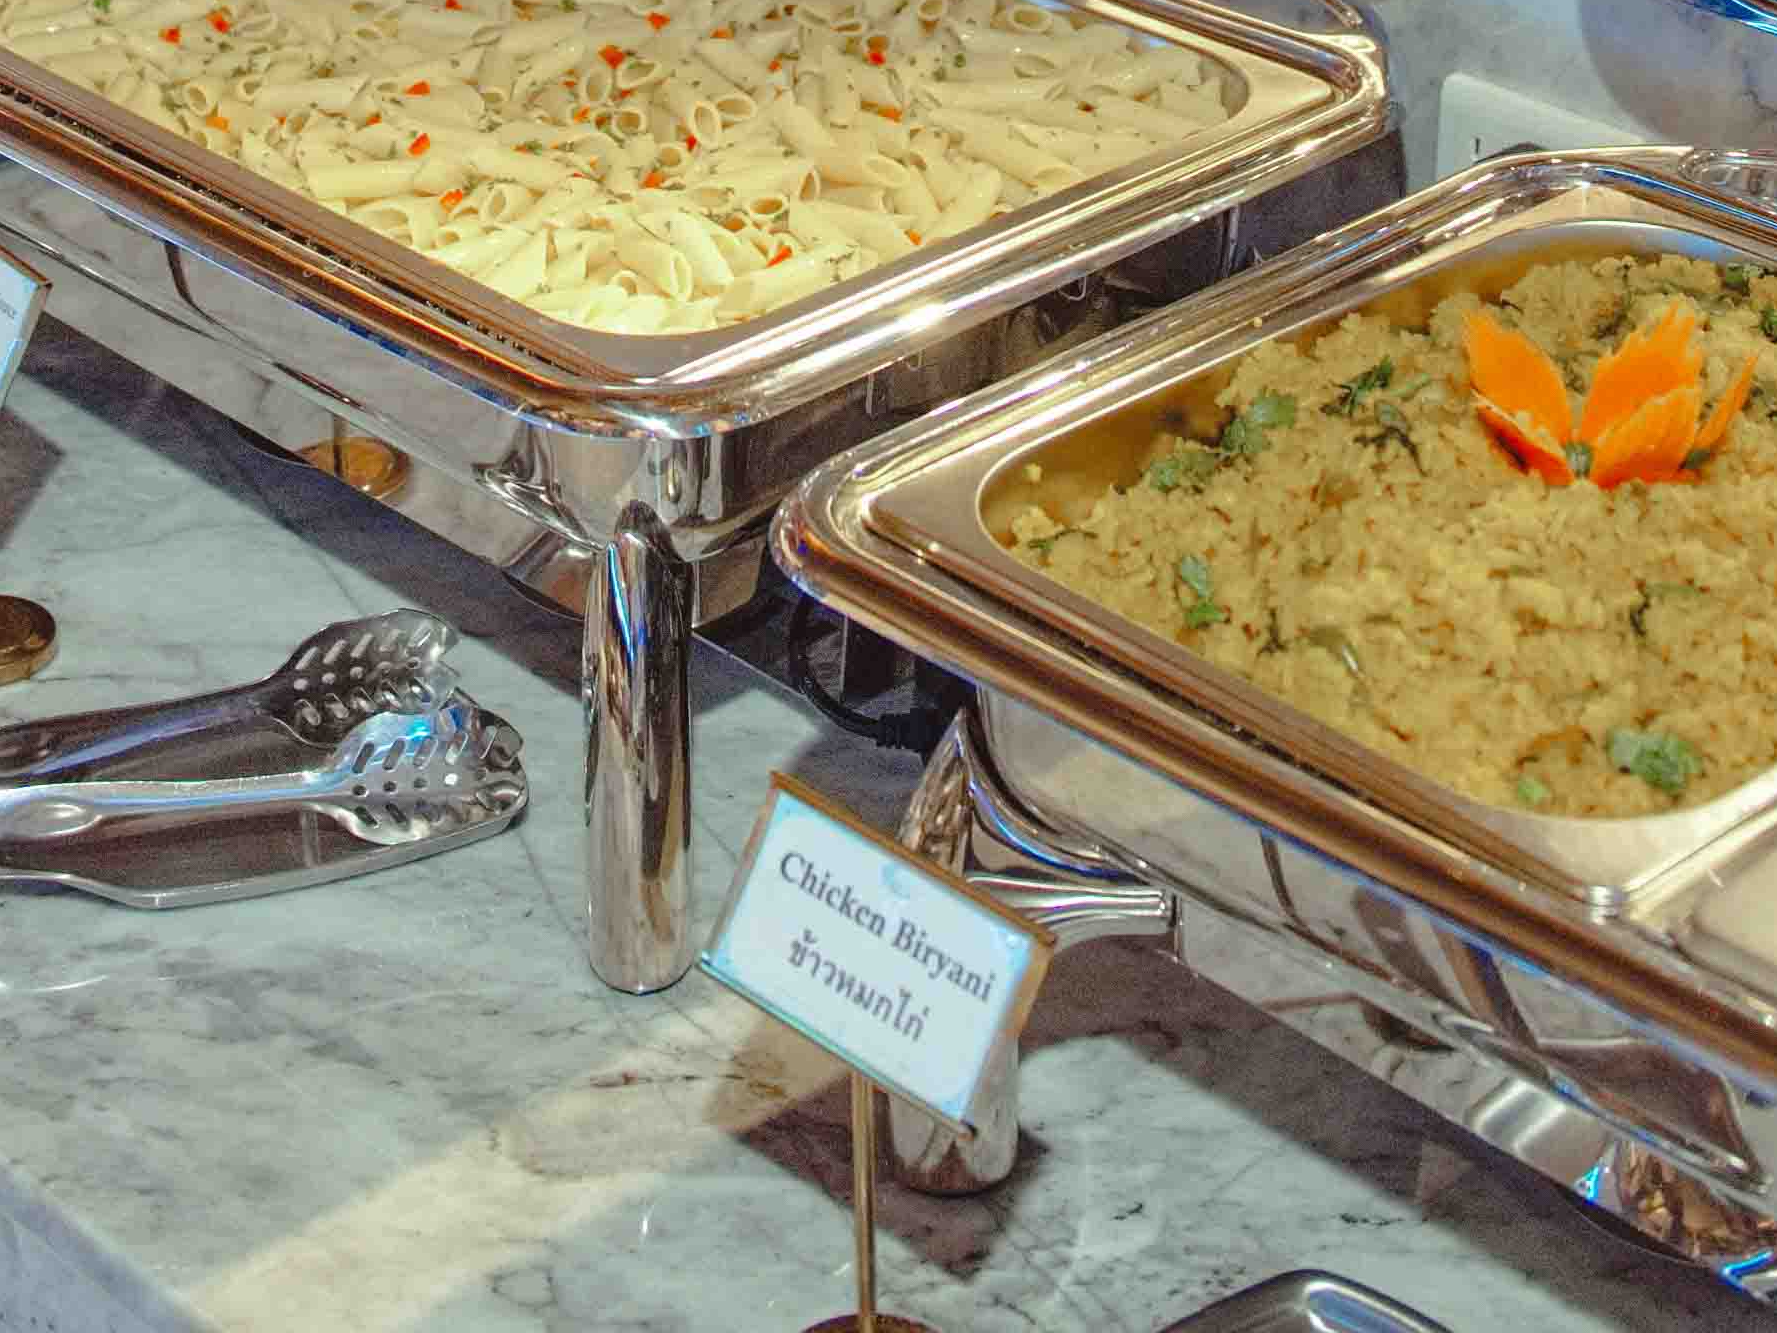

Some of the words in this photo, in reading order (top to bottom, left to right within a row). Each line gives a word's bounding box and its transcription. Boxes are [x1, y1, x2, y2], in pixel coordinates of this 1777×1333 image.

[778, 851, 889, 938] Chicken
[891, 917, 996, 1004] Biryani
[787, 928, 932, 1042] ข้าวหมกไก่
